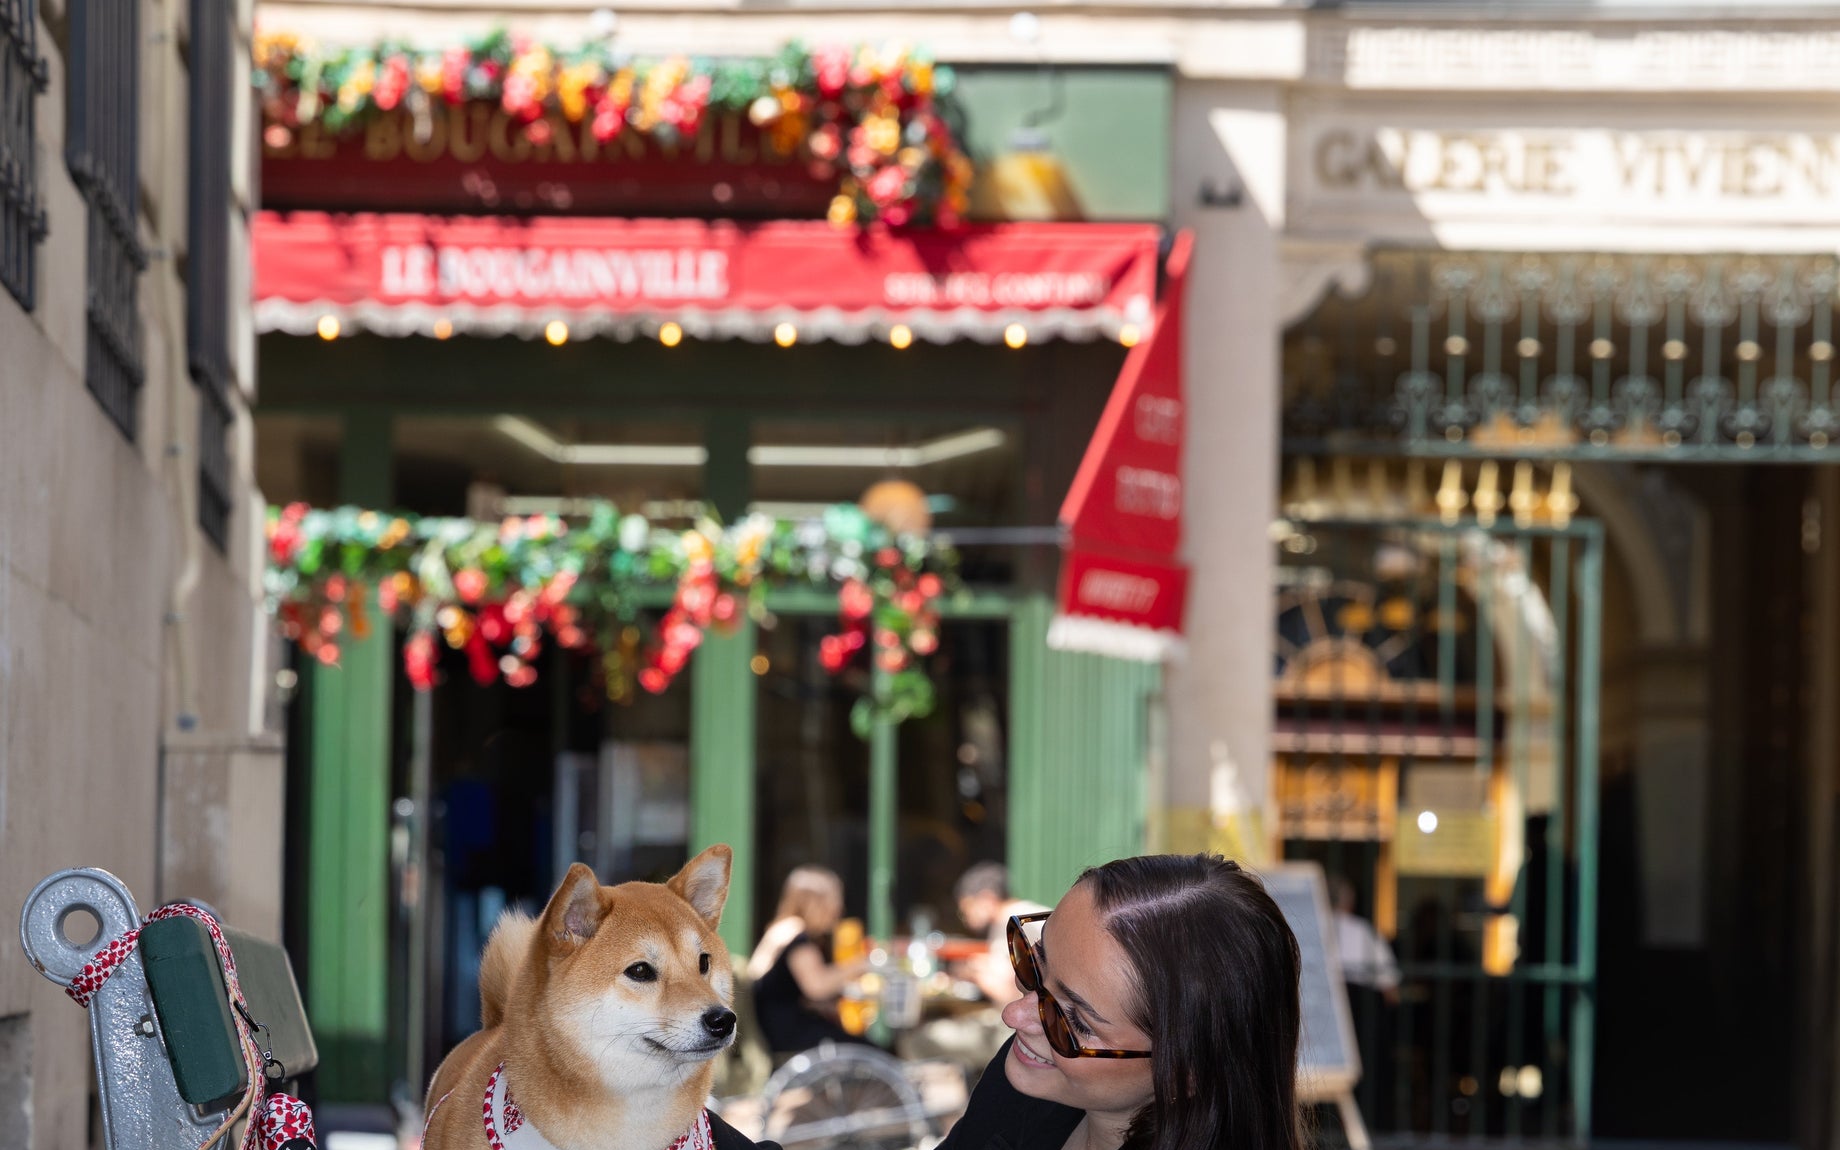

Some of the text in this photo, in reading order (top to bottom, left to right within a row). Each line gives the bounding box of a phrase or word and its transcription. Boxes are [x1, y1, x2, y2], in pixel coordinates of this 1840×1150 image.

[1315, 128, 1576, 193] GALERIE
[382, 246, 728, 298] LE BOUGAINVILLE
